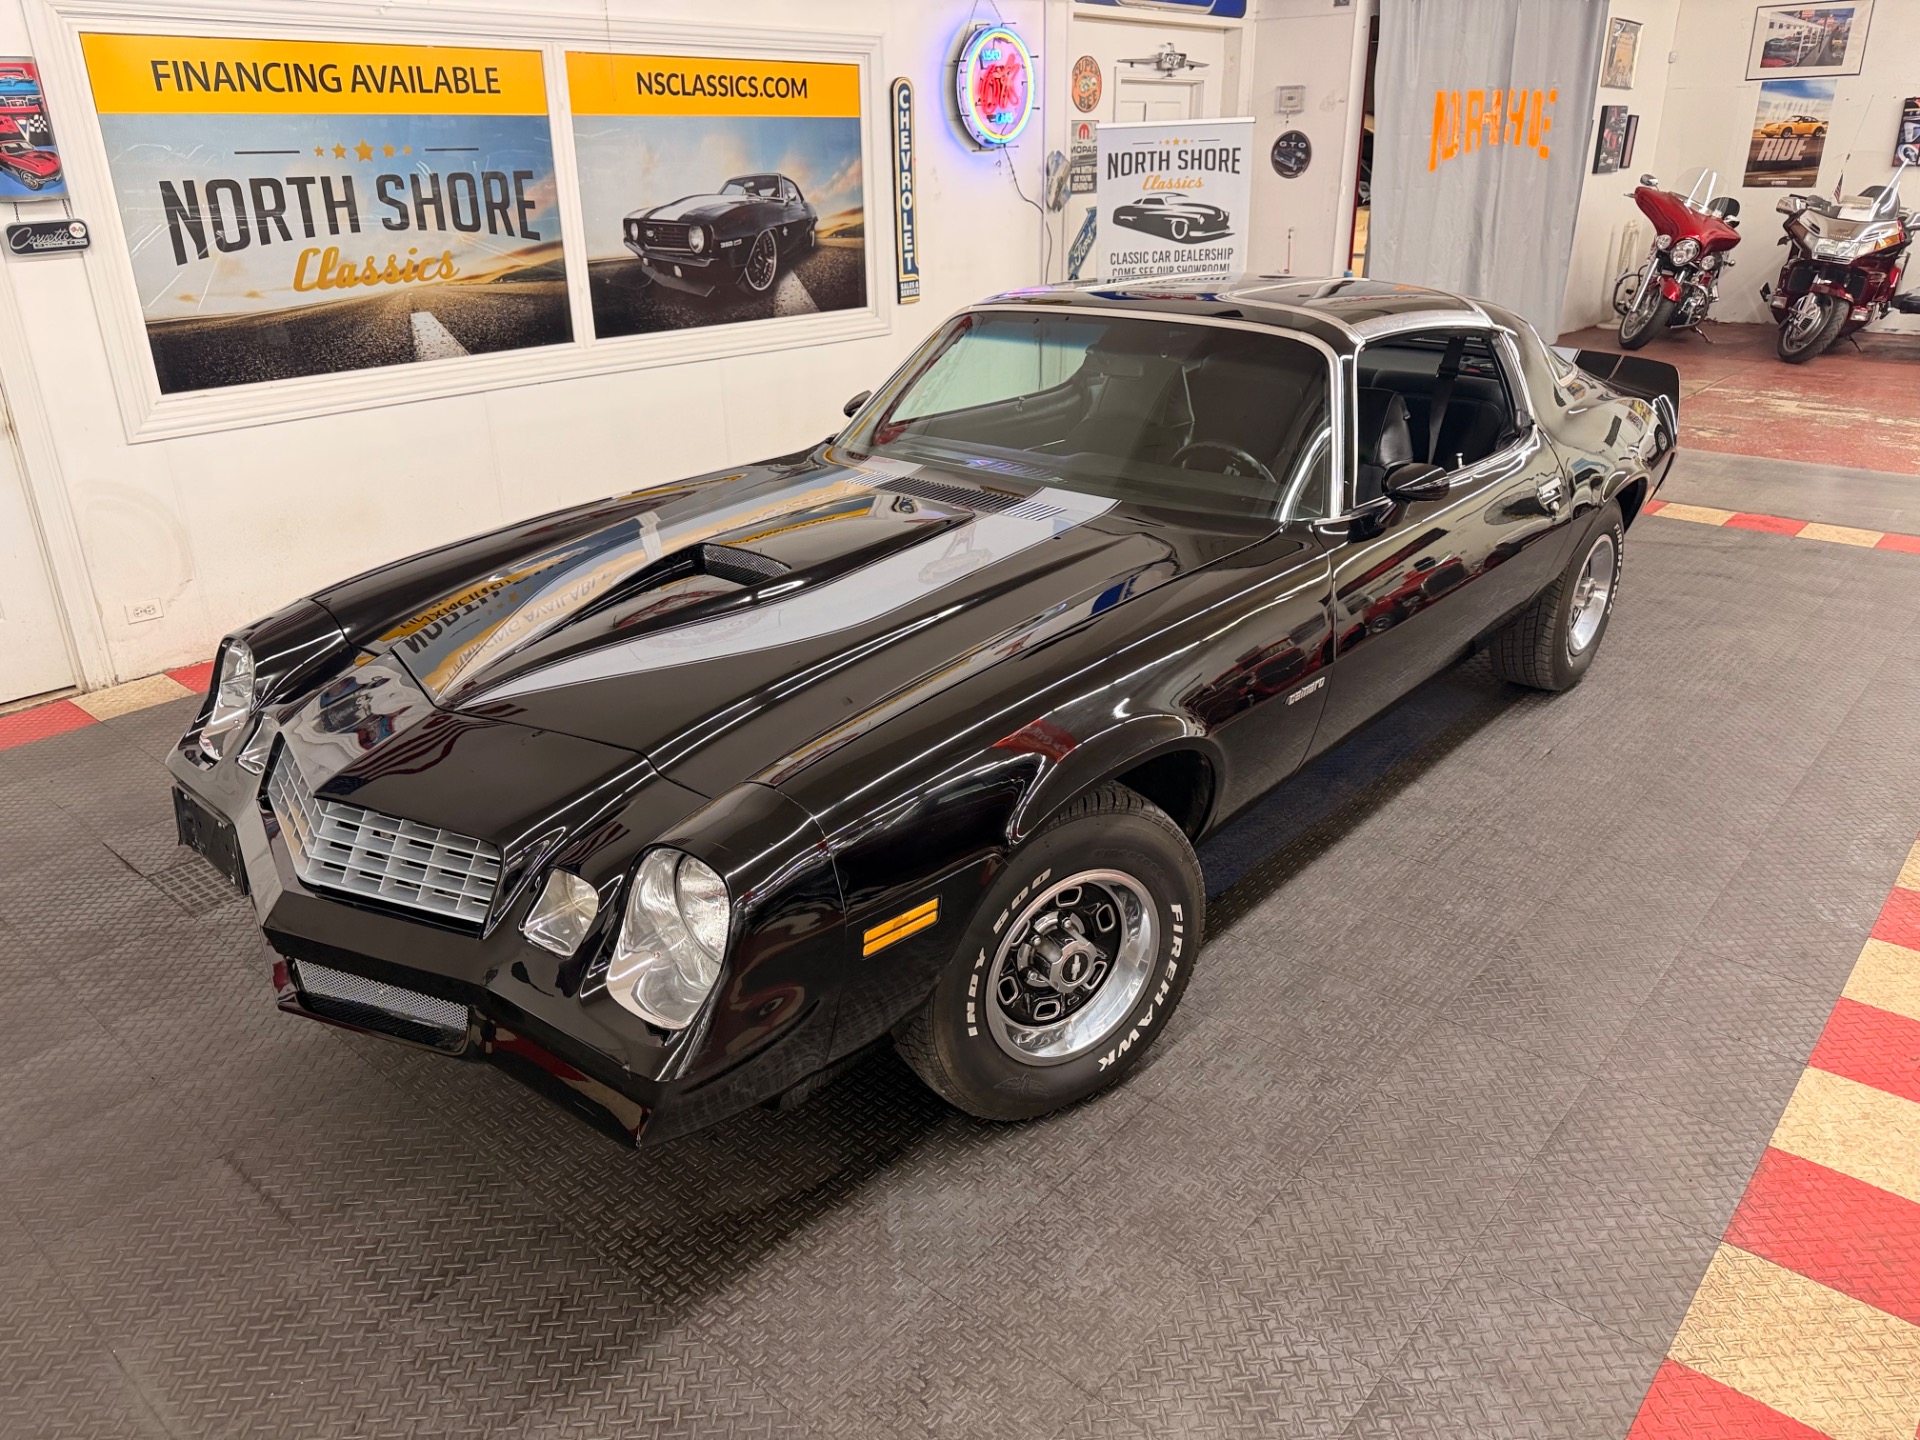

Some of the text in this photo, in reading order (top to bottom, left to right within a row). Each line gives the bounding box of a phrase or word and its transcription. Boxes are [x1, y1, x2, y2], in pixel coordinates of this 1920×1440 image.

[982, 49, 1002, 60] USED
[150, 59, 502, 95] FINANCING AVAILABLE
[1073, 59, 1099, 83] SUPER
[636, 71, 809, 99] NSCLASSICS.COM
[1078, 89, 1098, 110] BEE
[1071, 145, 1097, 154] MOPAR
[1279, 141, 1306, 149] GTO
[1757, 138, 1810, 161] RIDE
[1107, 147, 1241, 181] NORTH SHORE
[899, 89, 914, 271] CHEVROLET
[1142, 174, 1204, 191] Classics
[159, 169, 542, 266] NORTH SHORE
[10, 227, 72, 249] Corvette
[1110, 247, 1234, 266] CLASSIC CAR DEALERSHIP
[293, 247, 461, 292] Classics
[1112, 267, 1136, 276] COME
[1139, 266, 1154, 275] SEE
[993, 868, 1051, 934] 500
[966, 947, 985, 1037] INDY
[1098, 903, 1184, 1072] FIREHAWK
